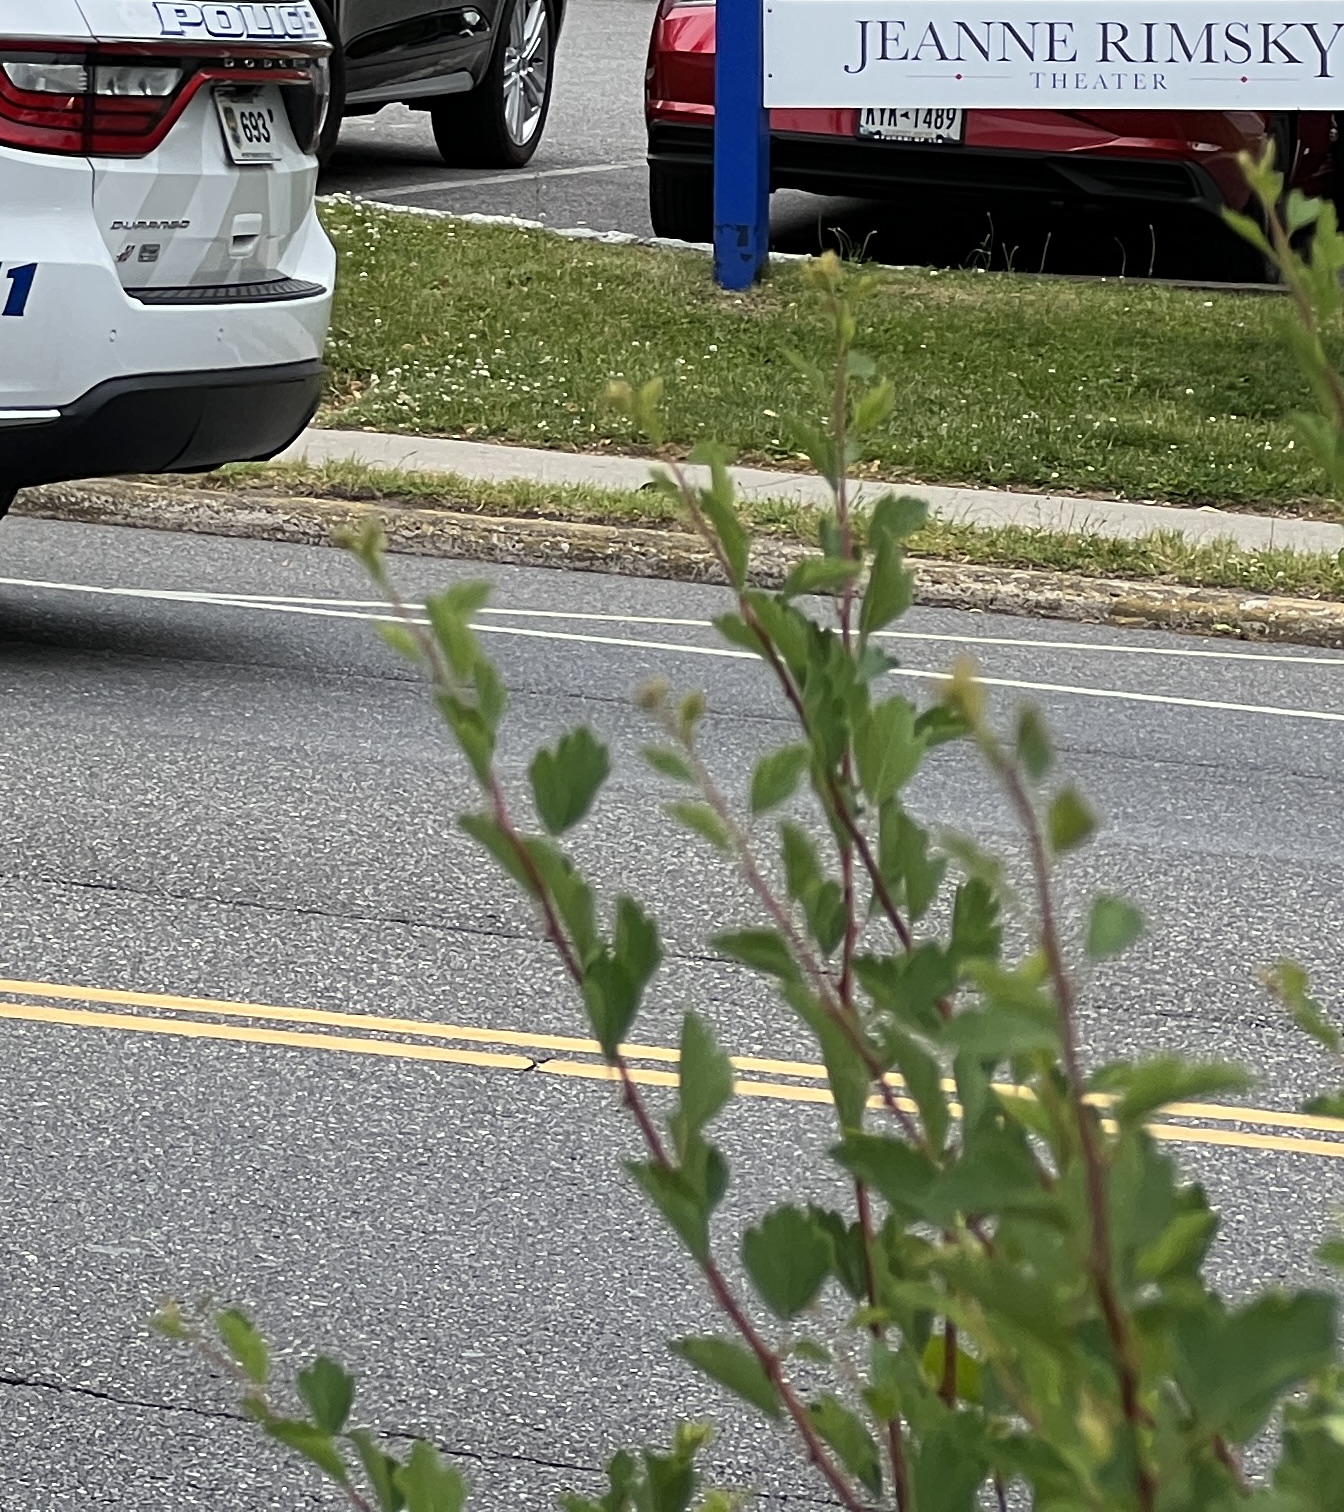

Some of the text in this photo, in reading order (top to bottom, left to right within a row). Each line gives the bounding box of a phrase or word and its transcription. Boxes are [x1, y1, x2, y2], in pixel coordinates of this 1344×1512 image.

[152, 1, 320, 39] POLICE
[844, 20, 1344, 79] JEANNE RIMSKY
[1029, 71, 1168, 91] THEATER
[240, 111, 271, 143] 693
[110, 220, 191, 231] DURANGO
